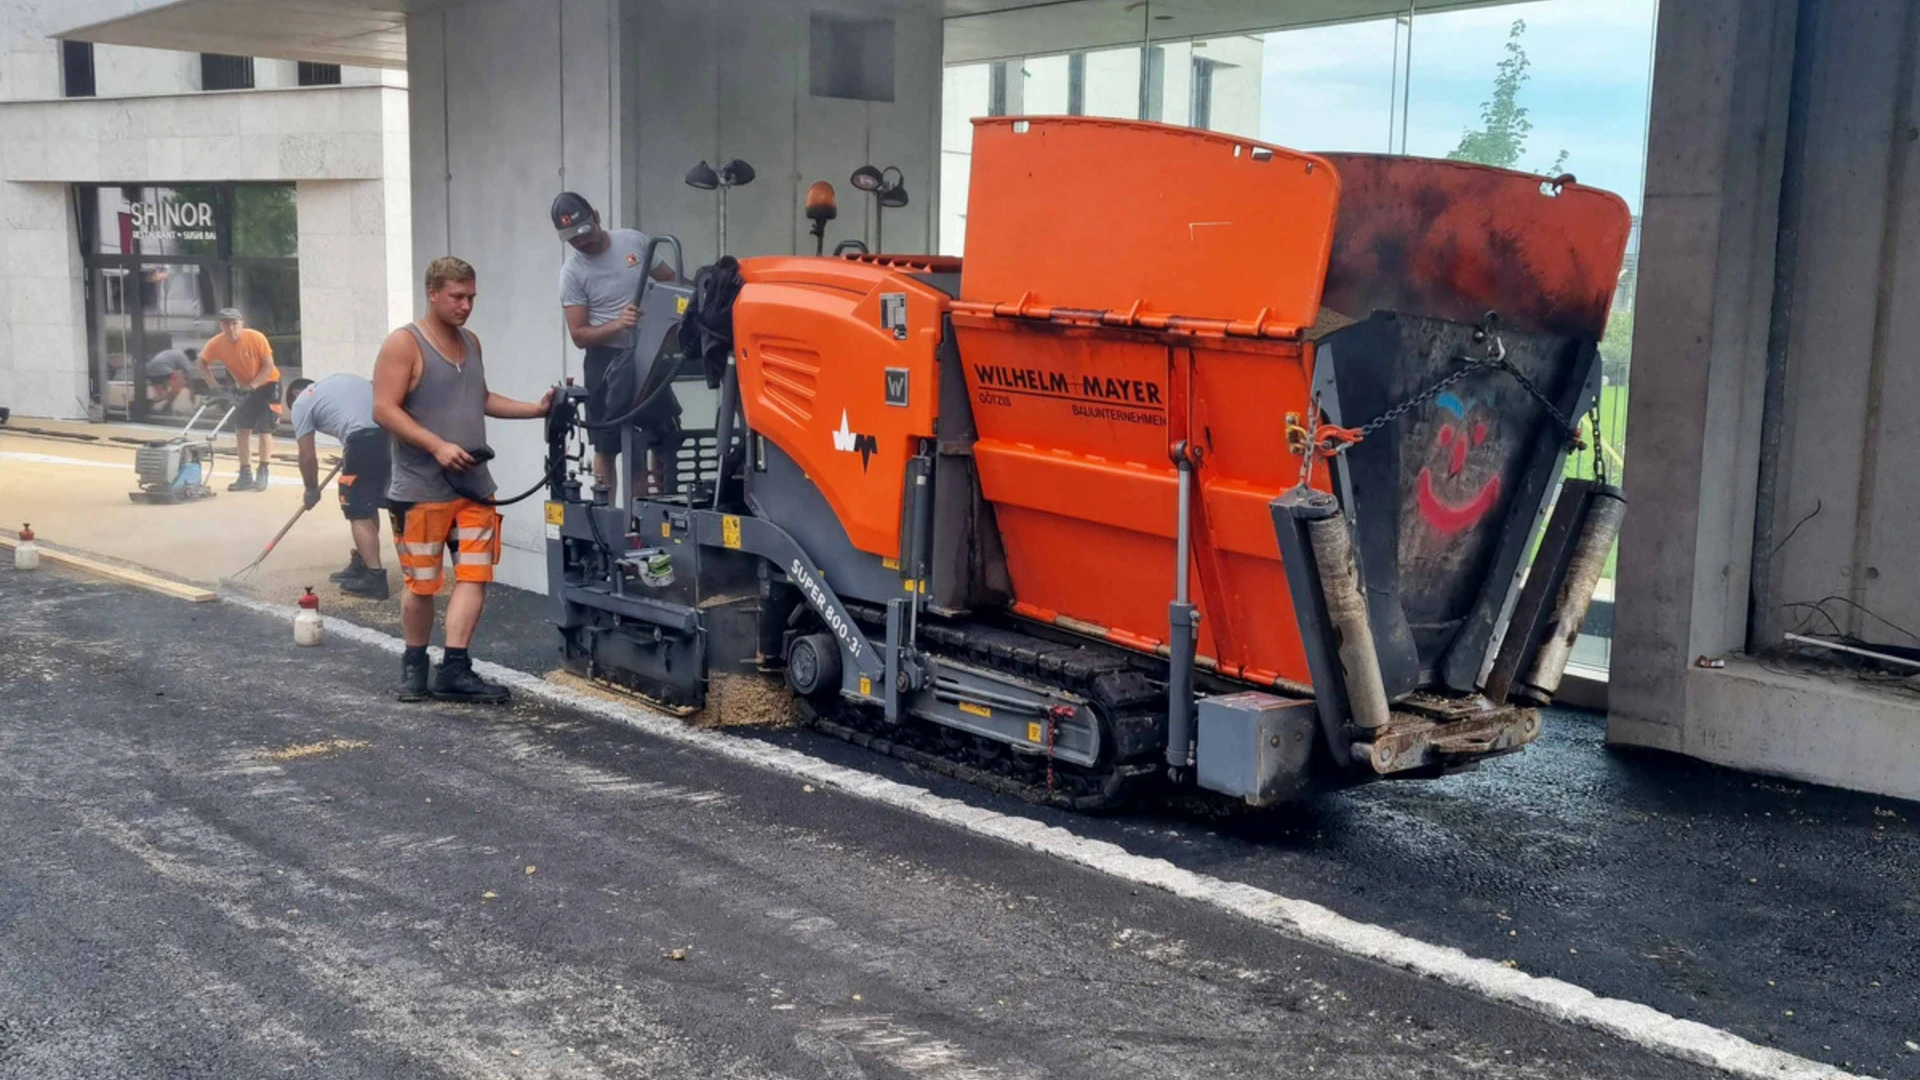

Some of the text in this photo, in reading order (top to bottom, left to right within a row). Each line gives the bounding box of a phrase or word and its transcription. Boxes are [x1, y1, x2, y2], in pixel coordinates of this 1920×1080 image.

[974, 364, 1069, 393] WILHELM
[1082, 375, 1162, 404] MAYER
[979, 391, 1012, 407] GÖTZIS
[1072, 404, 1166, 427] BAUUNTERNEHMEN
[791, 559, 862, 658] SUPER 800-3i
